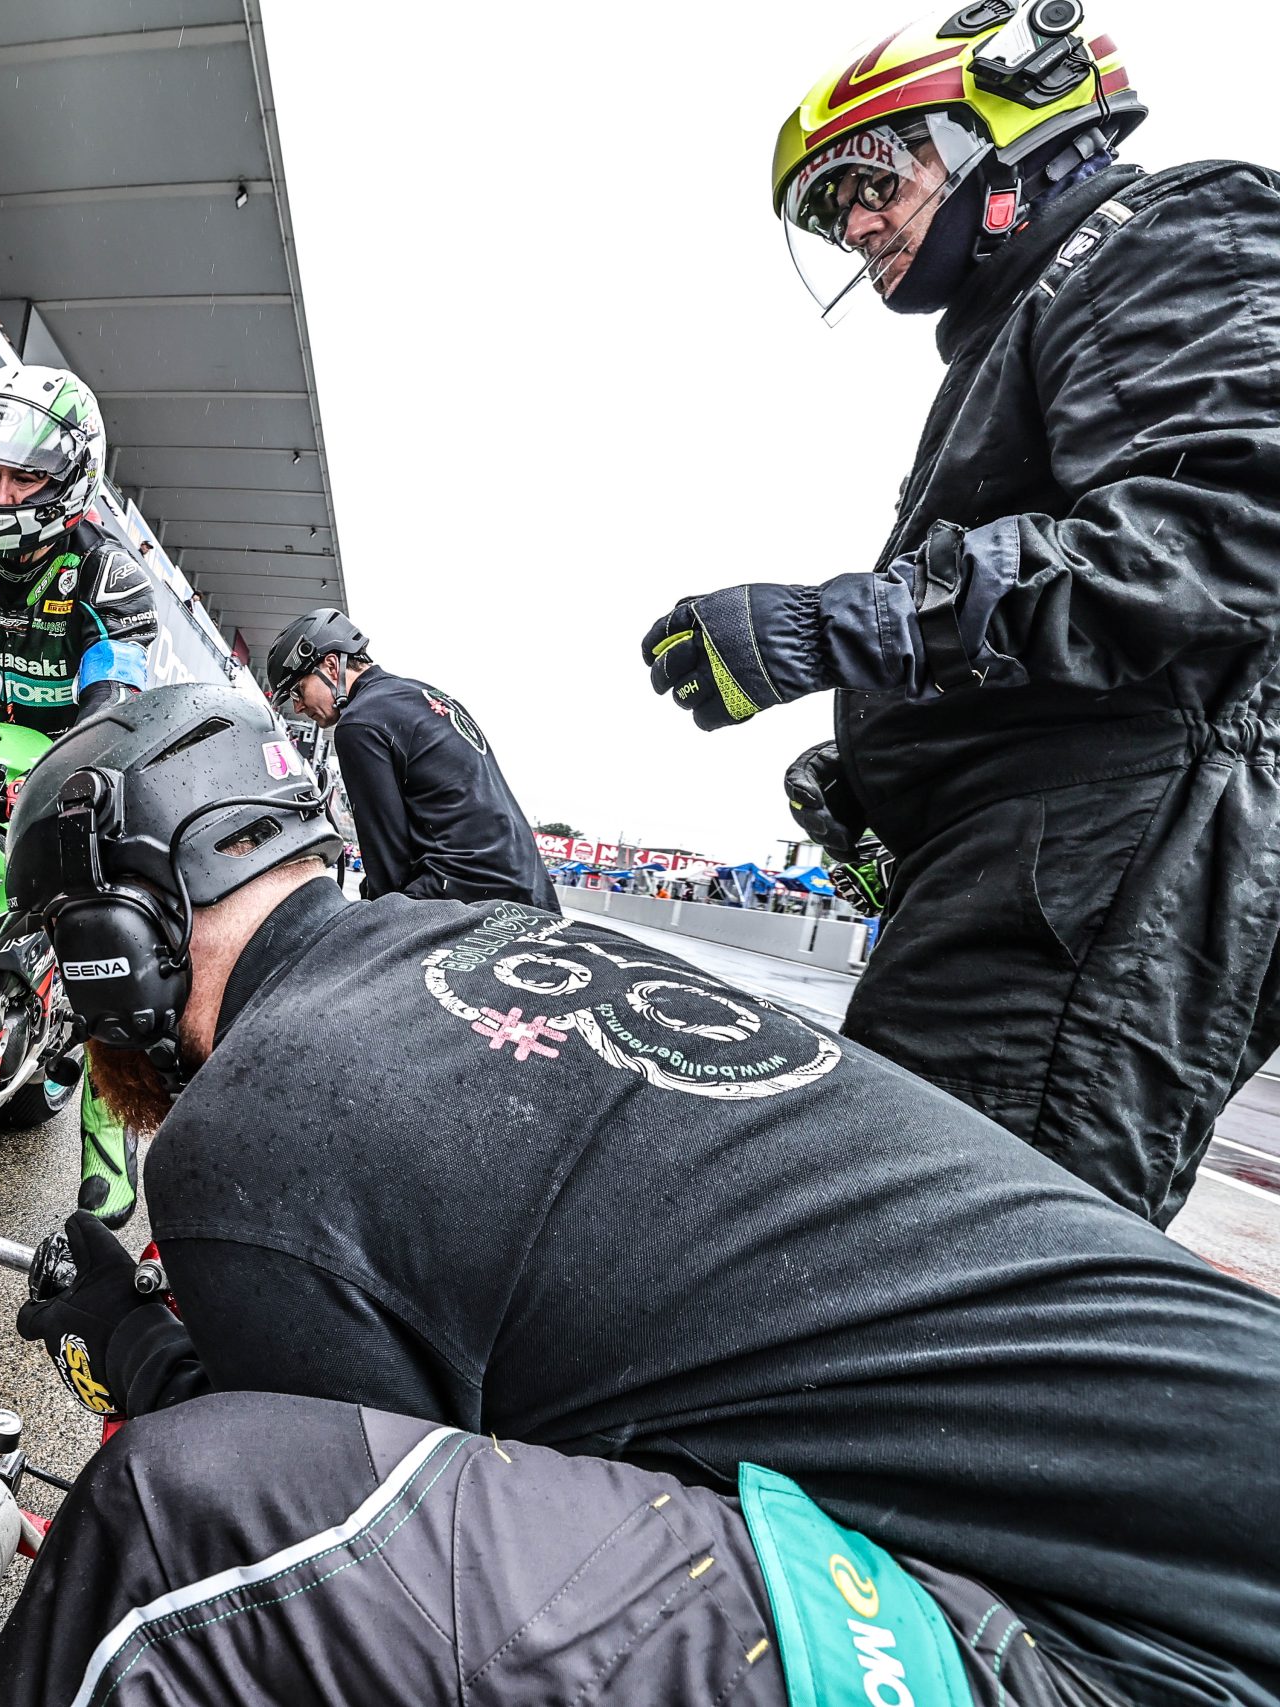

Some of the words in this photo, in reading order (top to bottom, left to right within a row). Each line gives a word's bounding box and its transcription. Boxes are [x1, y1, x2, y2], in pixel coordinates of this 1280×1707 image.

[33, 567, 55, 599] RST
[66, 962, 126, 977] SENA
[595, 1002, 788, 1079] www.bolligerteam.ch
